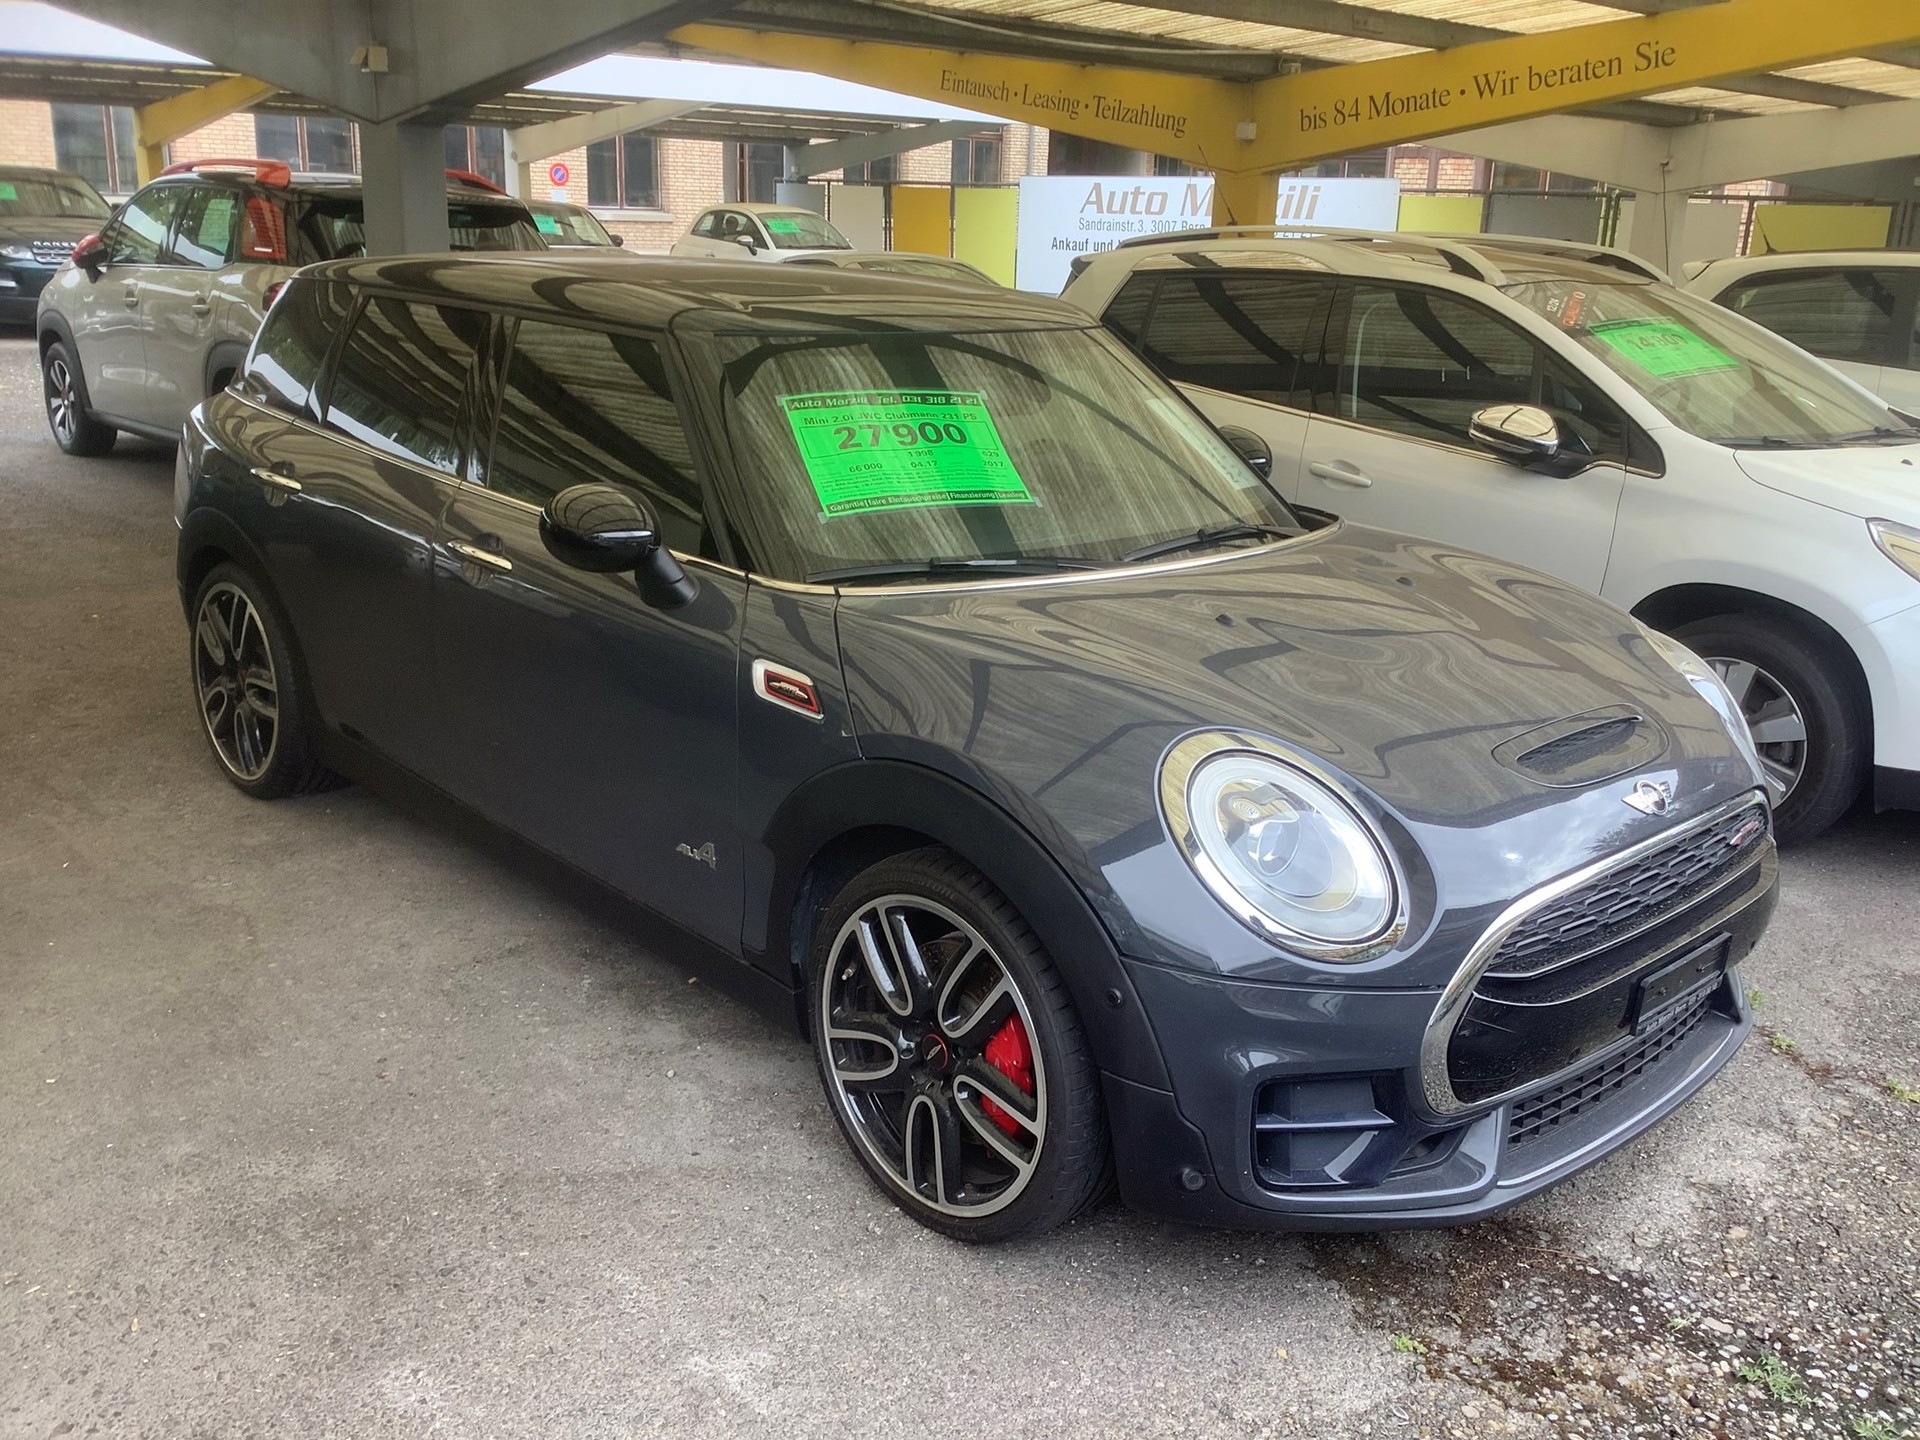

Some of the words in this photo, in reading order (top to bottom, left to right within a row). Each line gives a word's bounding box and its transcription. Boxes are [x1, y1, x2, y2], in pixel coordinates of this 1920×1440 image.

[1300, 108, 1328, 132] bis
[1334, 98, 1361, 127] 84
[1367, 87, 1451, 120] Monate
[1472, 70, 1520, 100] Wir
[1527, 55, 1623, 92] beraten
[1634, 41, 1677, 73] Sie
[940, 69, 1009, 102] Eintausch
[1022, 84, 1080, 119] Leasing
[1093, 95, 1187, 138] Teilzahlung
[1079, 182, 1168, 216] Auto
[1151, 220, 1177, 233] 3007
[1051, 237, 1089, 251] Ankauf
[1093, 239, 1113, 252] und
[791, 400, 822, 410] Auto
[878, 395, 897, 404] Tel.
[902, 395, 921, 403] 031
[926, 395, 946, 404] 318
[950, 396, 962, 404] 21
[966, 397, 977, 405] 21
[804, 417, 829, 425] Mini
[832, 413, 854, 423] 2.0i
[885, 411, 939, 420] Clubmann
[833, 421, 968, 450] 27'900
